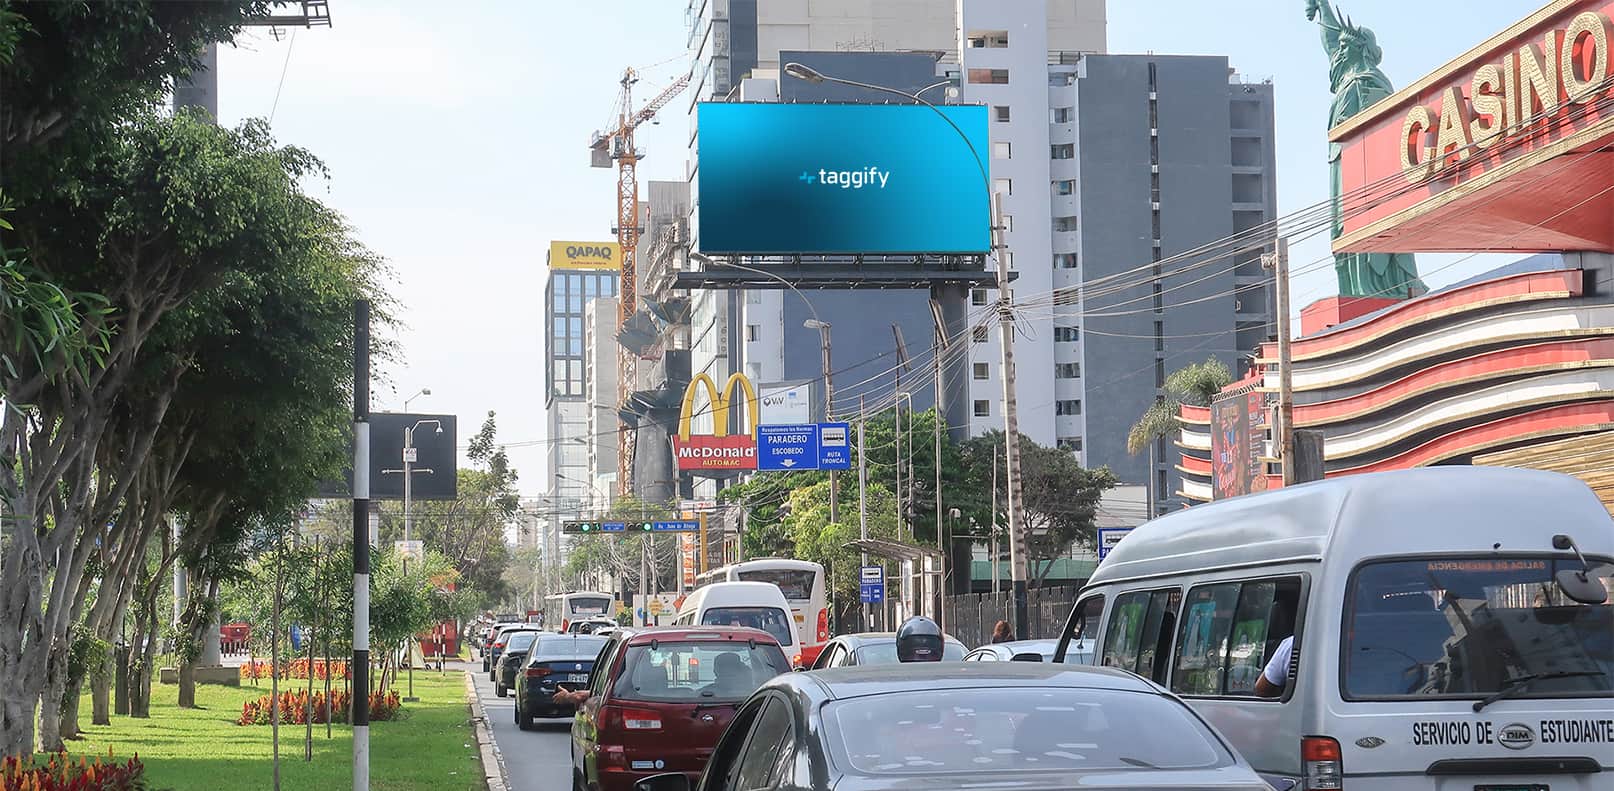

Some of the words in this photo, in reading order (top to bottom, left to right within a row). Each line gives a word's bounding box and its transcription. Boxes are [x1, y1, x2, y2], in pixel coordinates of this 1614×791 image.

[1400, 12, 1608, 184] CASINO
[819, 166, 890, 188] taggify
[566, 246, 612, 260] QAPAQ
[768, 435, 808, 444] PARADERO
[772, 447, 804, 455] ESCOBEDO
[1413, 722, 1471, 745] SERVICIO
[1476, 721, 1493, 744] DE
[1540, 720, 1614, 743] ESTUDIANTE
